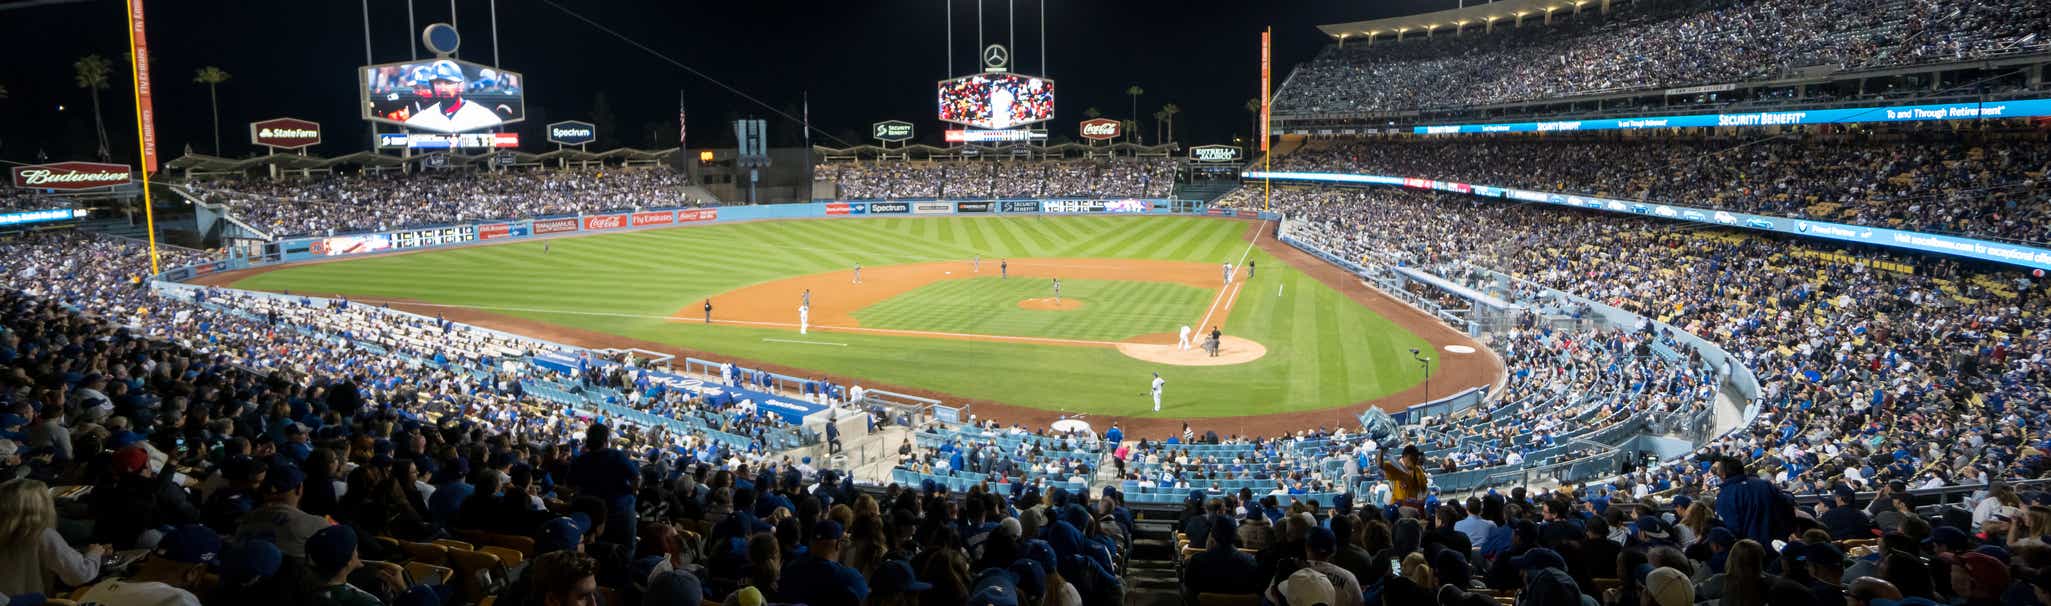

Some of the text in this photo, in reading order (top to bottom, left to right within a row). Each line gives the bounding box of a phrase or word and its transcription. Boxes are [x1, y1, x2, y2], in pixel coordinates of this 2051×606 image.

[1887, 106, 2002, 119] To and Through Retirement
[1719, 114, 1760, 126] SECURITY
[553, 128, 590, 137] Spectrum
[20, 169, 129, 185] Budweiser
[872, 204, 906, 213] Spectrum
[632, 214, 645, 225] Fly
